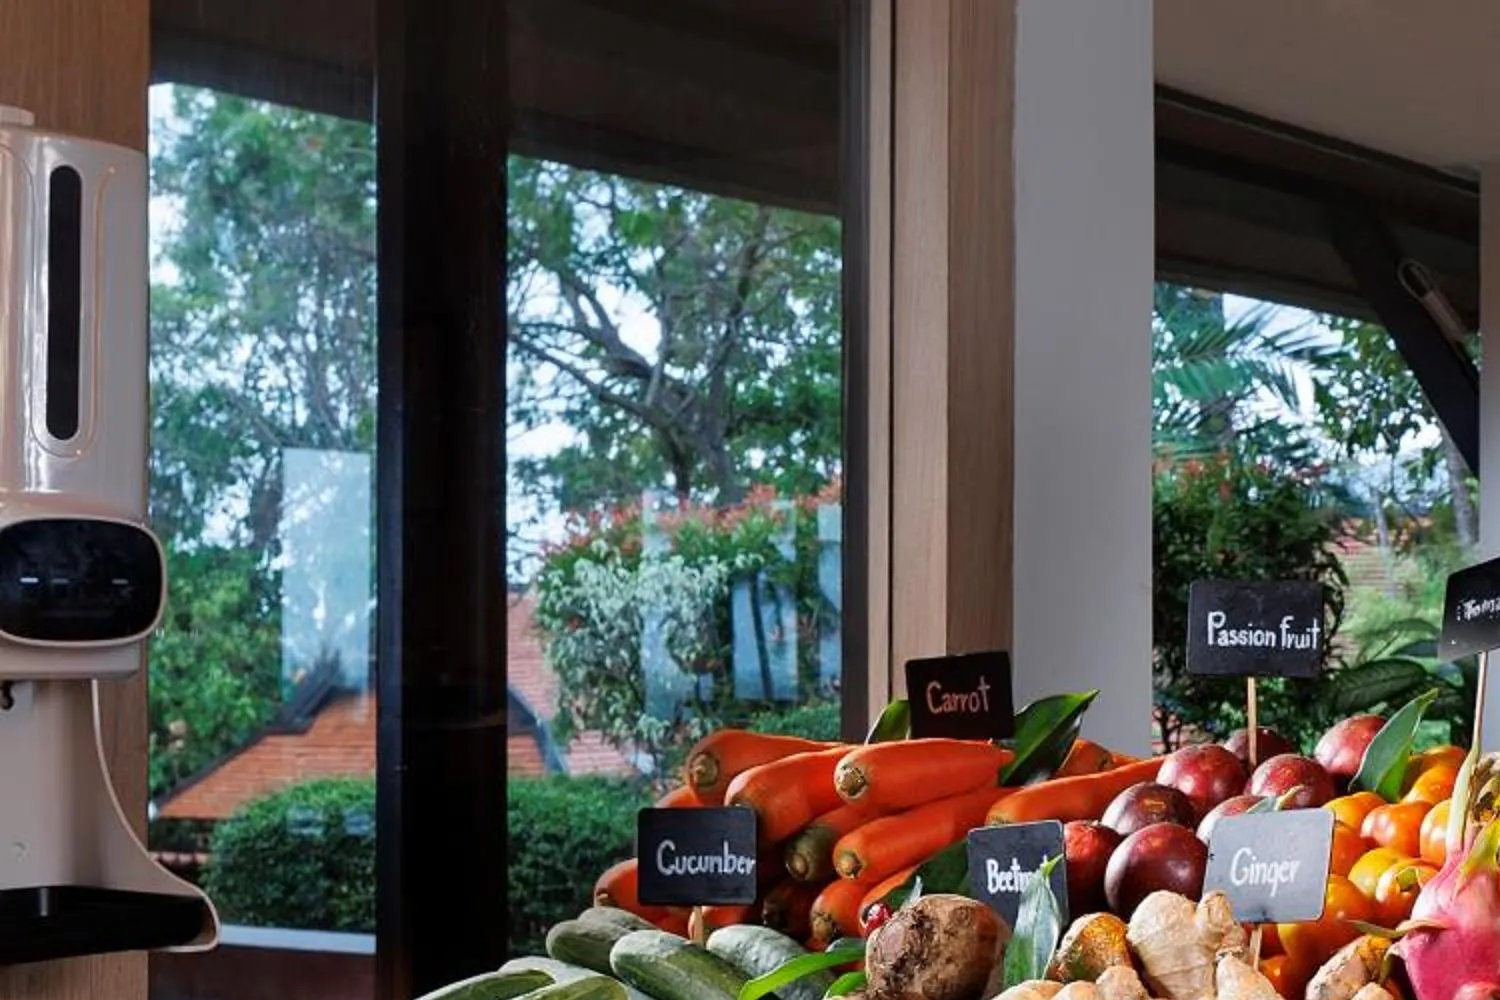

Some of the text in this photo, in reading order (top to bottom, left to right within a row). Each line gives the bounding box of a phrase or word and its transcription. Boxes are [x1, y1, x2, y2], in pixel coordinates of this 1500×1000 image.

[1206, 610, 1321, 650] Passion fruit
[926, 674, 991, 715] Carrot
[1230, 847, 1301, 898] Ginger
